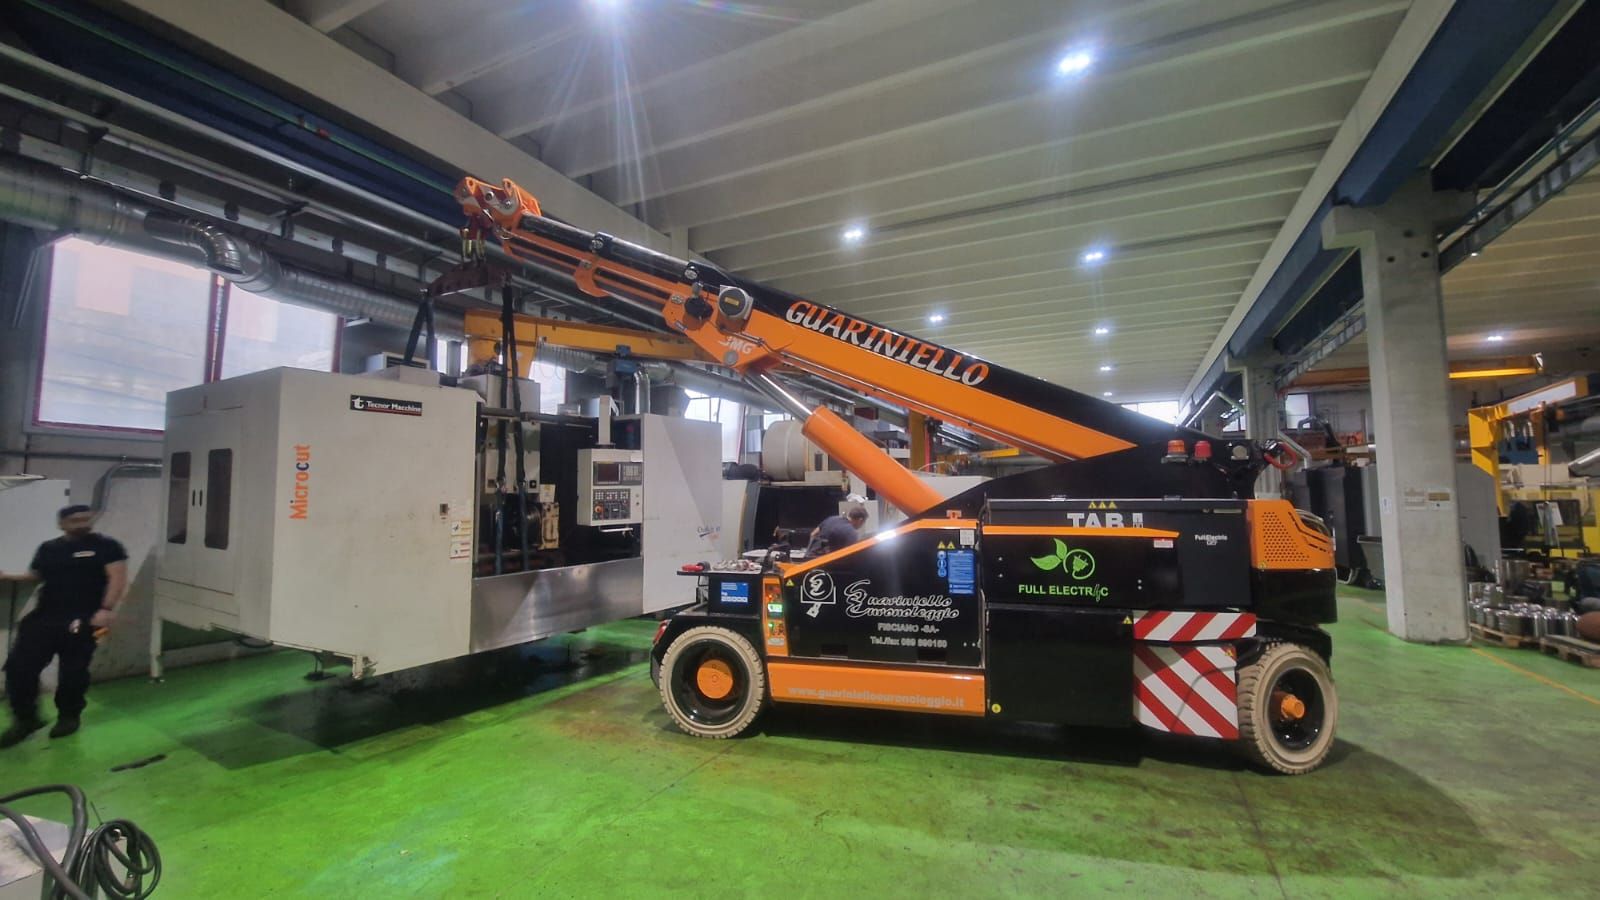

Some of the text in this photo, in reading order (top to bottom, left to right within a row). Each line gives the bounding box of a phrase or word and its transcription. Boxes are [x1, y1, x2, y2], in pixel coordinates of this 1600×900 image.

[785, 300, 990, 386] GUARINIELLO
[366, 400, 391, 409] Tecnor
[391, 402, 421, 412] Macchine
[289, 444, 311, 519] Microcut
[1018, 584, 1046, 595] FULL
[877, 622, 919, 633] FISCIANO
